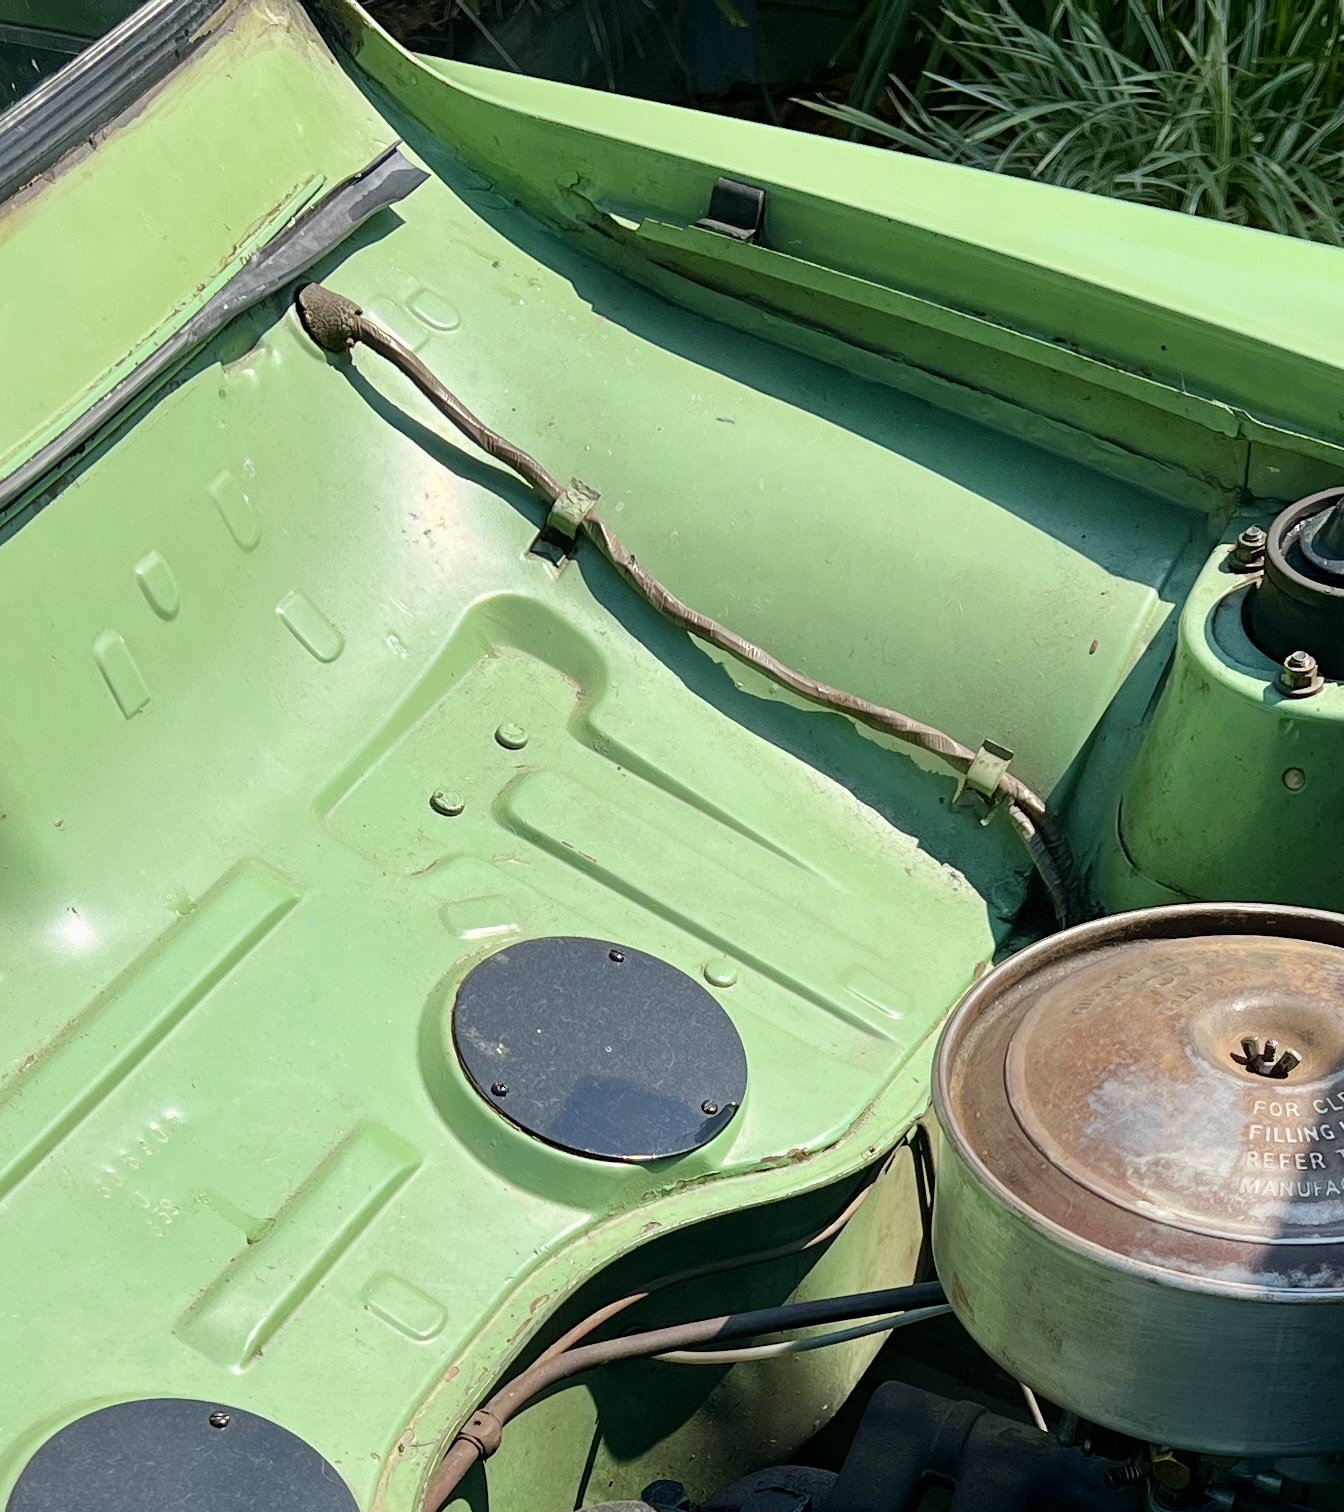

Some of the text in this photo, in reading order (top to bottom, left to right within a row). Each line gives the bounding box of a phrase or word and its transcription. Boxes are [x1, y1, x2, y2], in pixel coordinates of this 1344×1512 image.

[1252, 1100, 1301, 1117] FOR
[1248, 1124, 1336, 1144] FILLING
[1245, 1150, 1327, 1171] REFER
